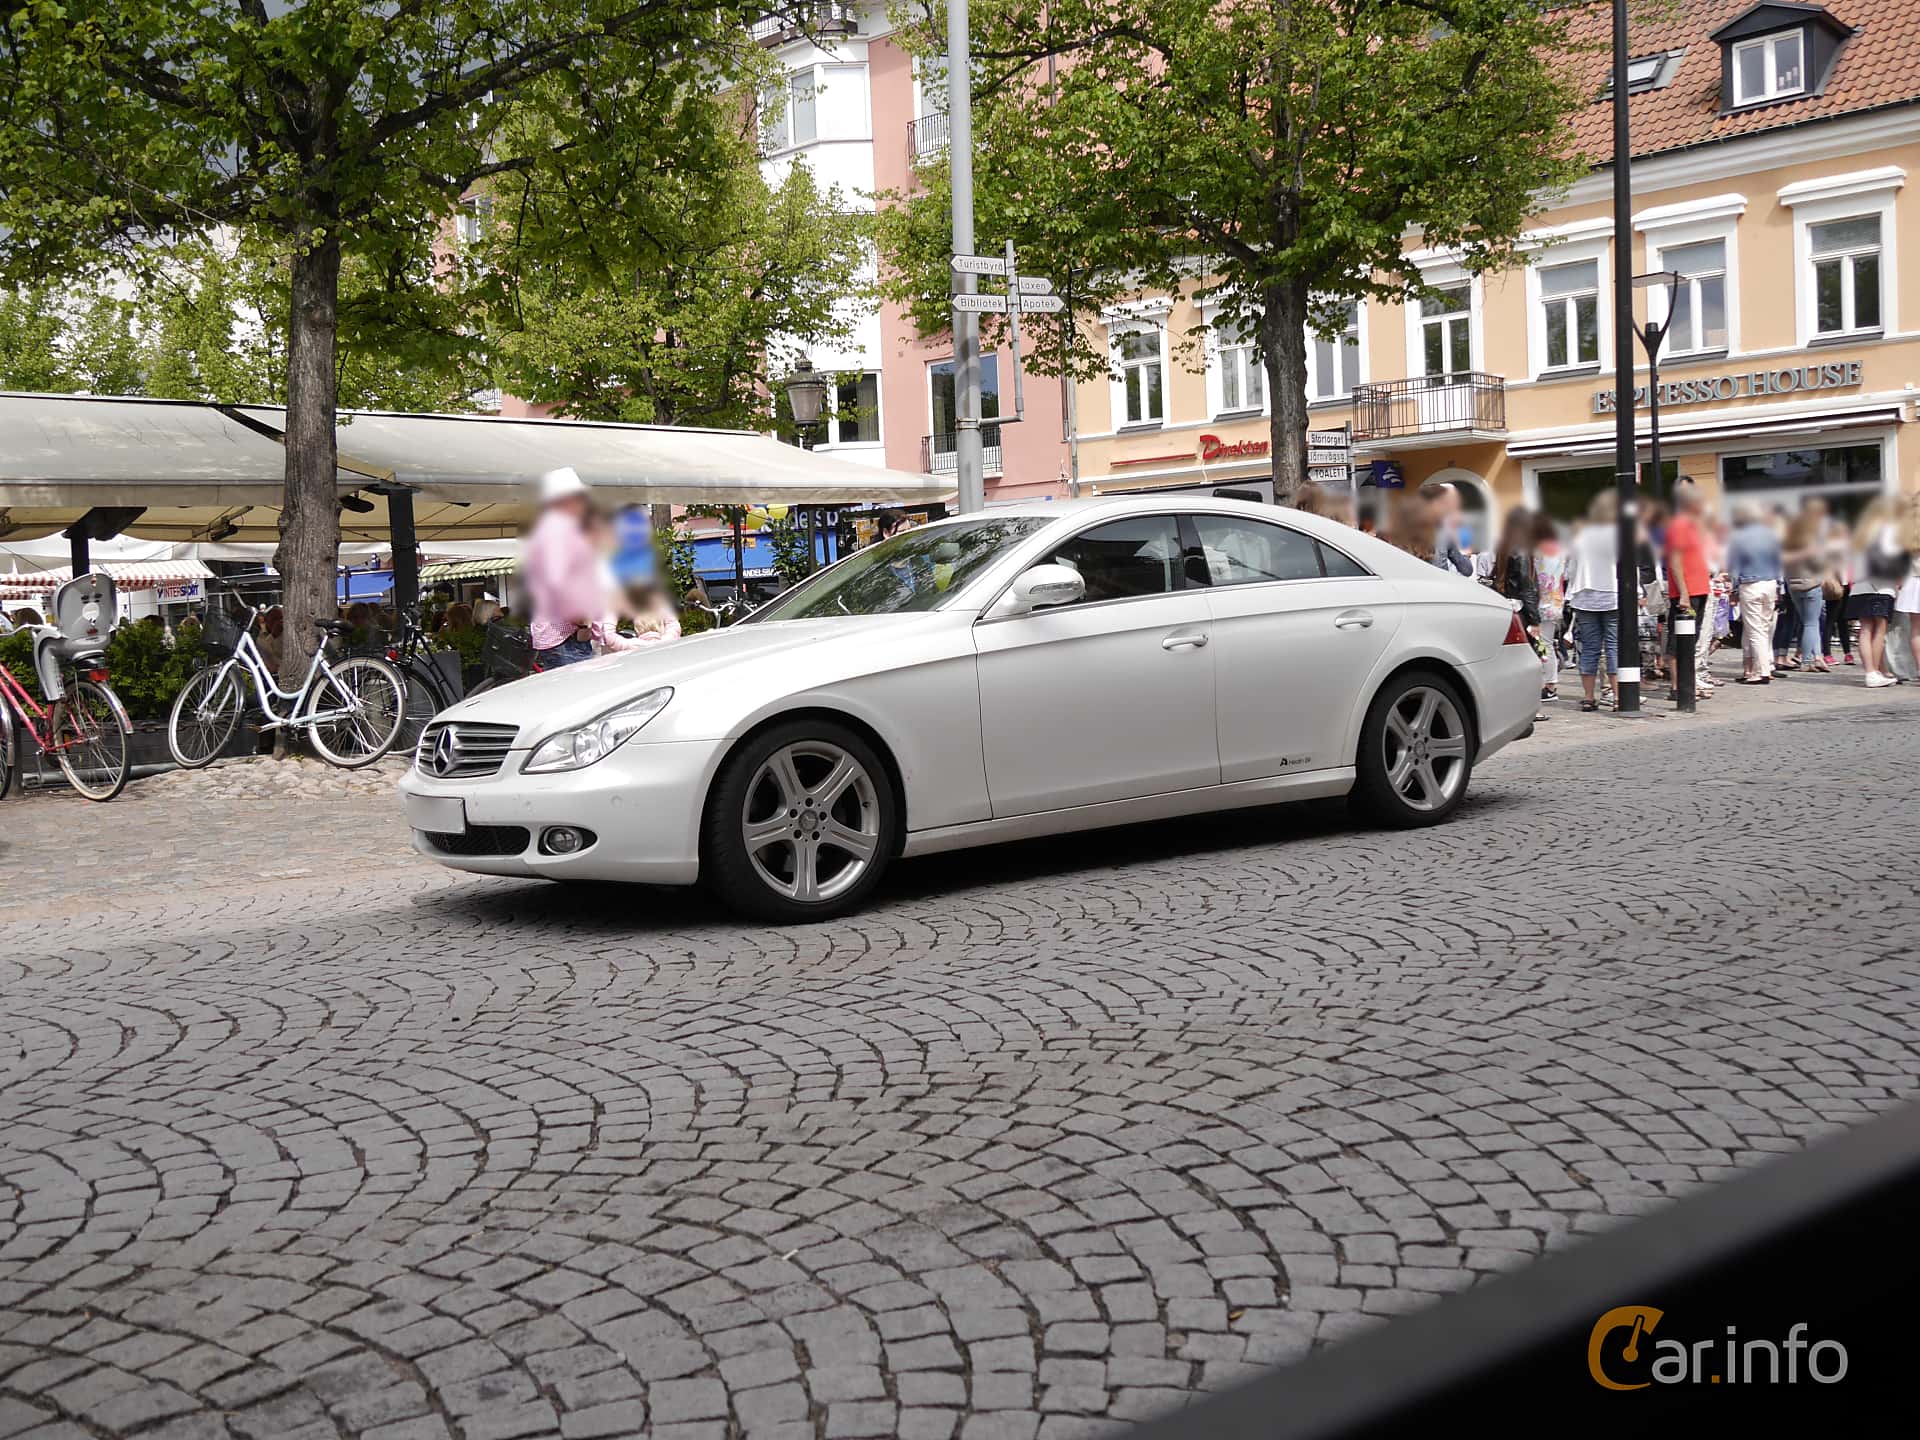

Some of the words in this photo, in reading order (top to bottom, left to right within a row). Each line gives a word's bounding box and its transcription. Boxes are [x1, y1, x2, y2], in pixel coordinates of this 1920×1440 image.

[1021, 280, 1046, 290] Laxen
[960, 297, 1004, 308] Bibliotek
[1023, 299, 1056, 309] Apotek
[1747, 360, 1864, 396] HOUSE
[1315, 468, 1345, 478] TOALETT
